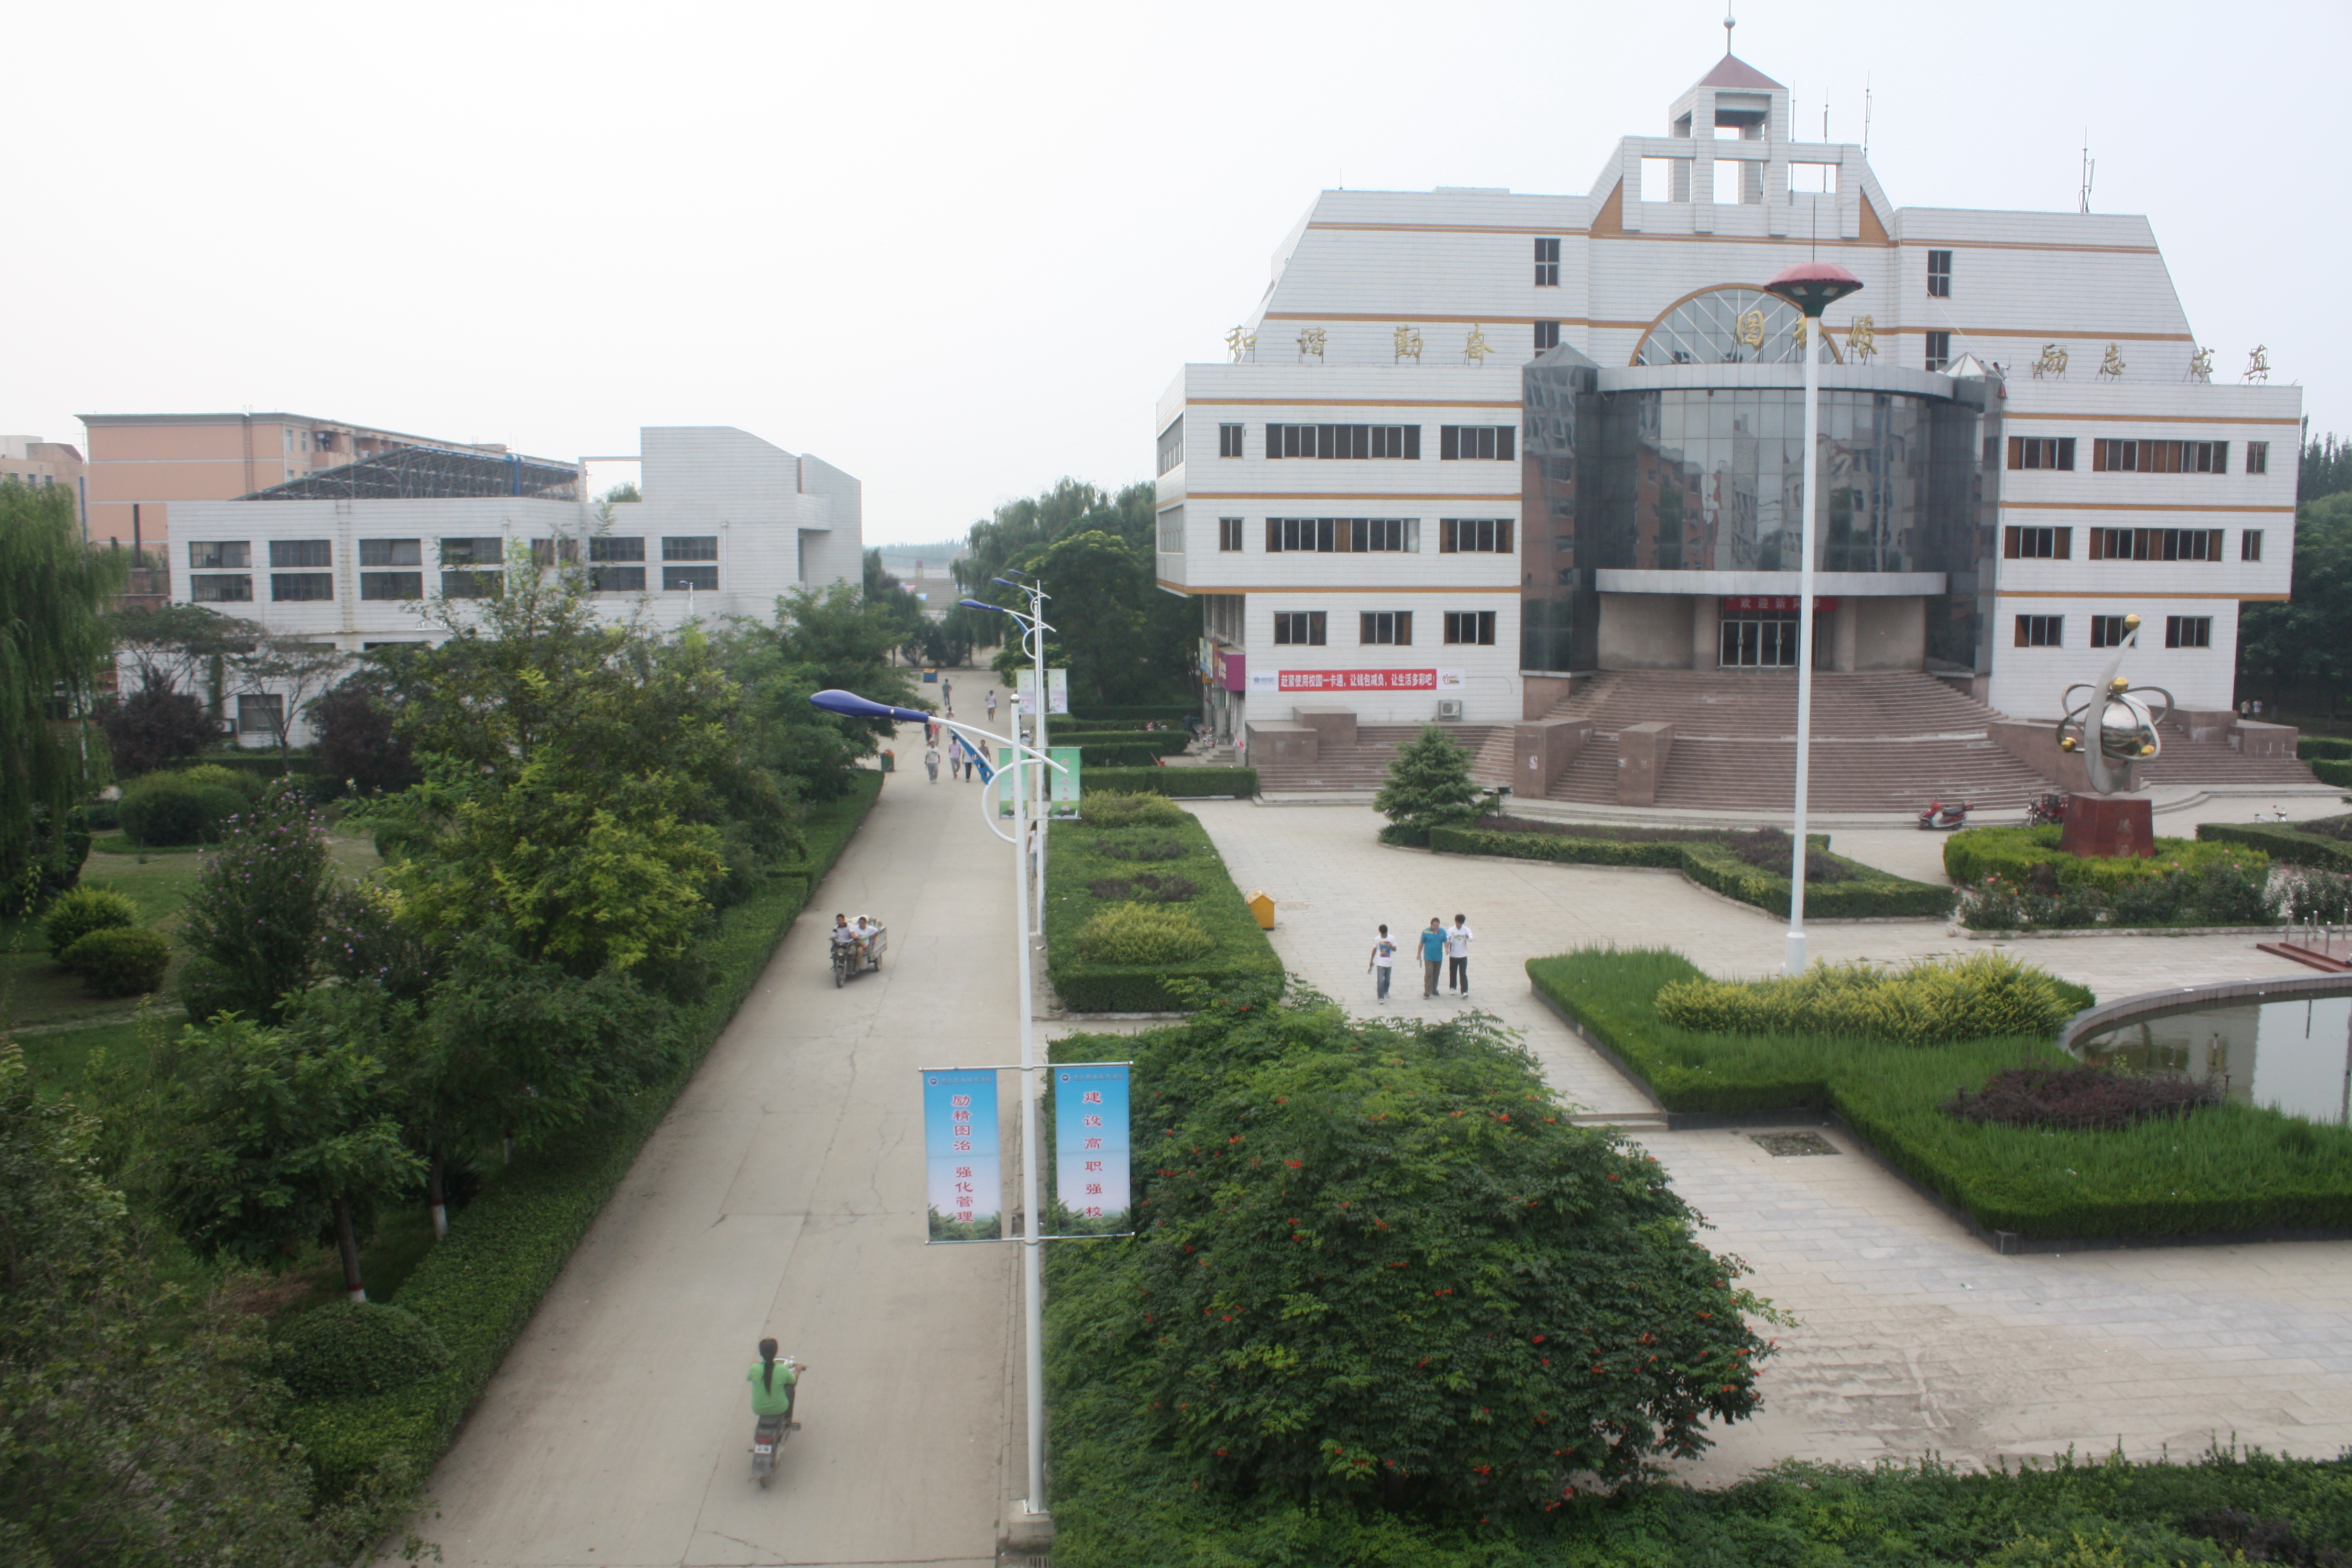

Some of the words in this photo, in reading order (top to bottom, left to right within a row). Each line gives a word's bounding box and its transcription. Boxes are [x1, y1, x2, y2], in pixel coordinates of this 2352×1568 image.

[952, 1095, 972, 1151] 励精图治
[1082, 1091, 1103, 1218] 建设高职强校
[955, 1167, 974, 1222] 强化管理
